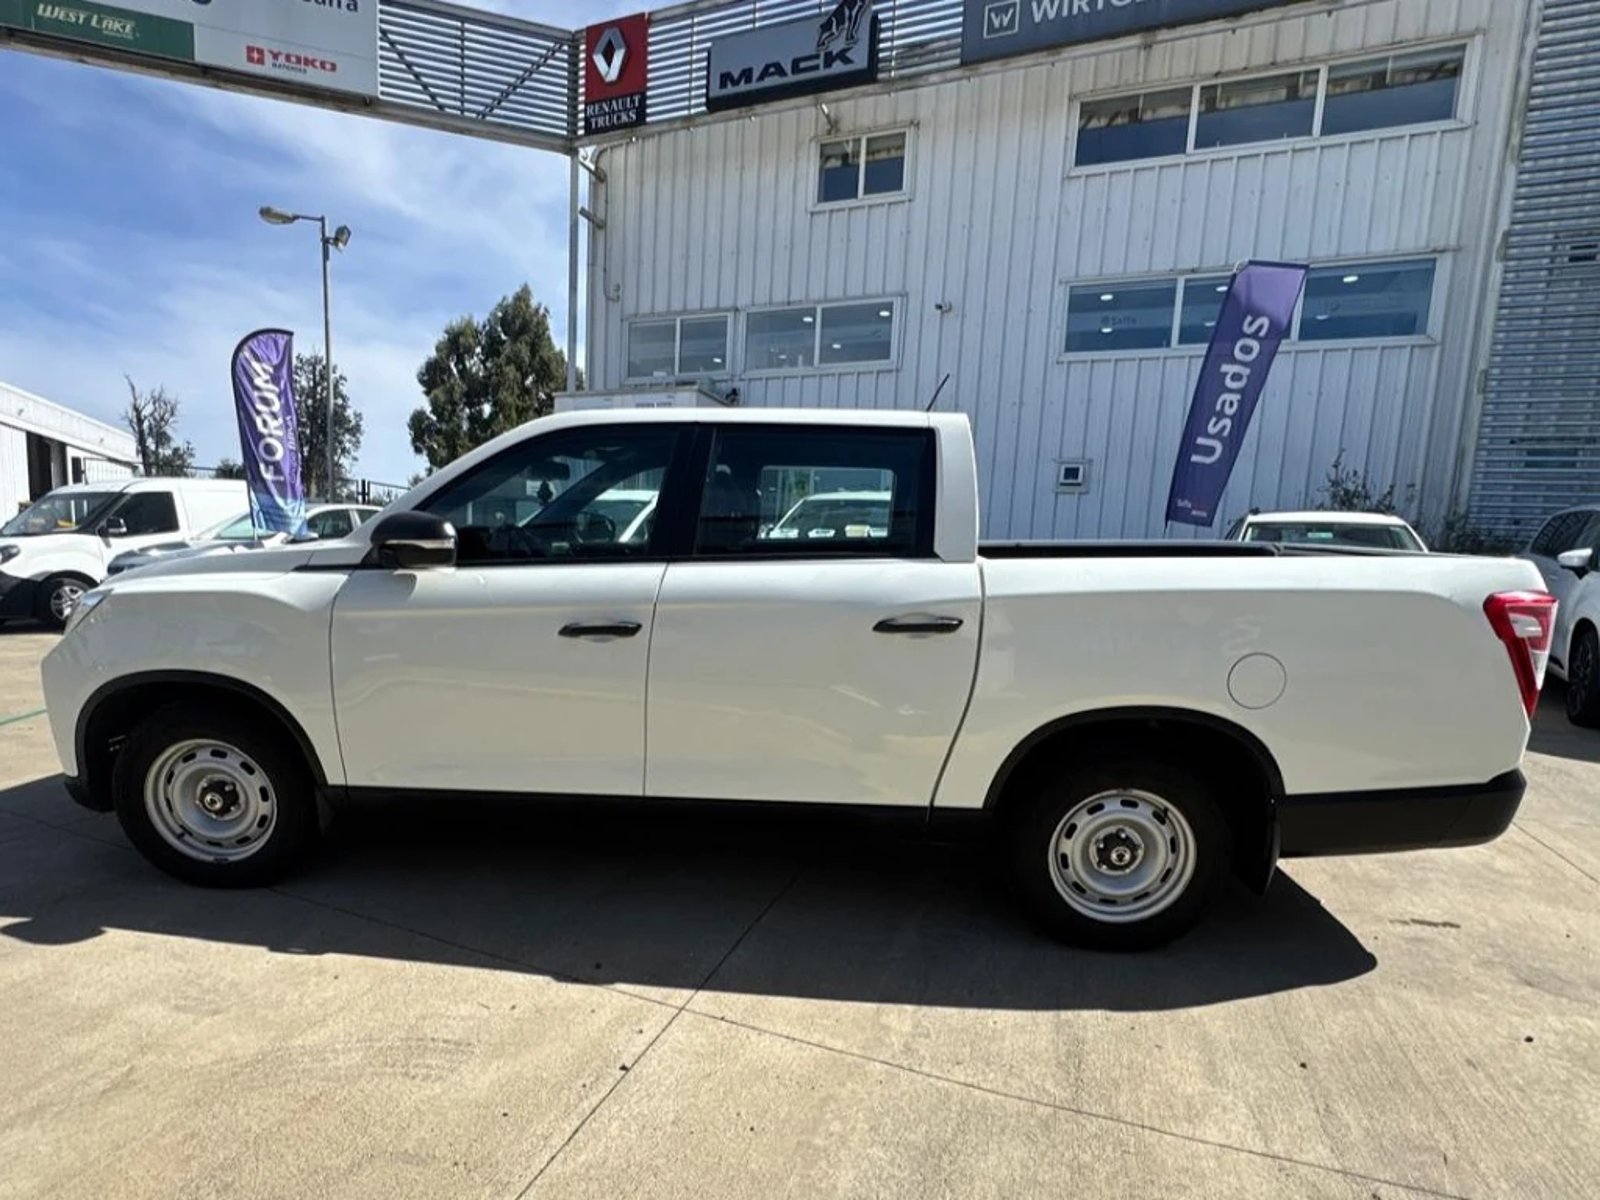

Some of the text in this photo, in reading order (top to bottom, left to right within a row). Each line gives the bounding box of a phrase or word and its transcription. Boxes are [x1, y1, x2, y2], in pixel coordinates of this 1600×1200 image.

[37, 3, 134, 34] WEST LAKE
[268, 49, 337, 73] YOKO
[719, 47, 855, 90] MACK
[586, 95, 641, 118] RENAULT
[590, 110, 637, 130] TRUCKS
[1190, 314, 1270, 465] Usados
[247, 354, 284, 481] FORUM
